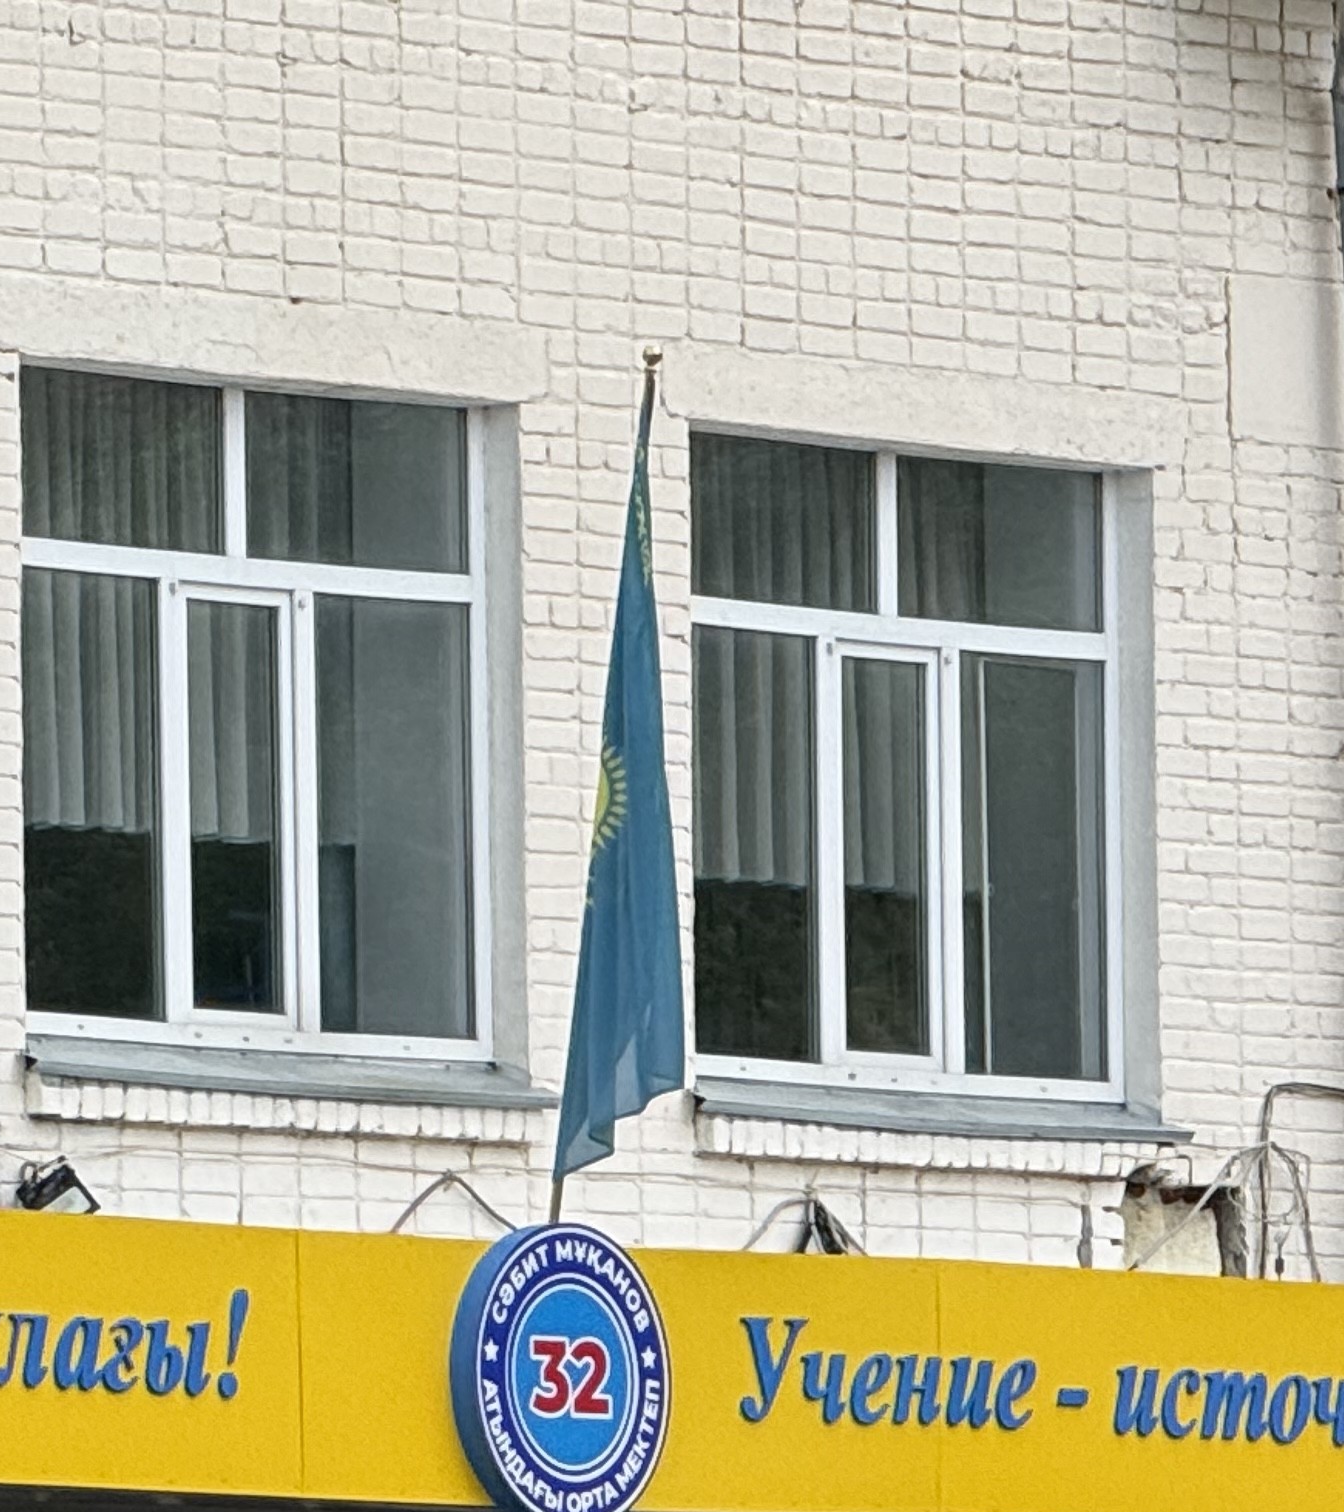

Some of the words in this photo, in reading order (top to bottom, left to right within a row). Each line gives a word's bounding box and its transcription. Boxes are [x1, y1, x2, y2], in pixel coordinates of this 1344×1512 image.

[492, 1243, 549, 1324] СӘБИТ
[555, 1238, 650, 1333] МҰҚАНОВ
[530, 1335, 613, 1419] 32
[739, 1317, 1036, 1430] Учение
[1057, 1388, 1089, 1407] -
[483, 1379, 564, 1512] АТЫНДАҒЫ
[615, 1378, 661, 1491] МЕКТЕП
